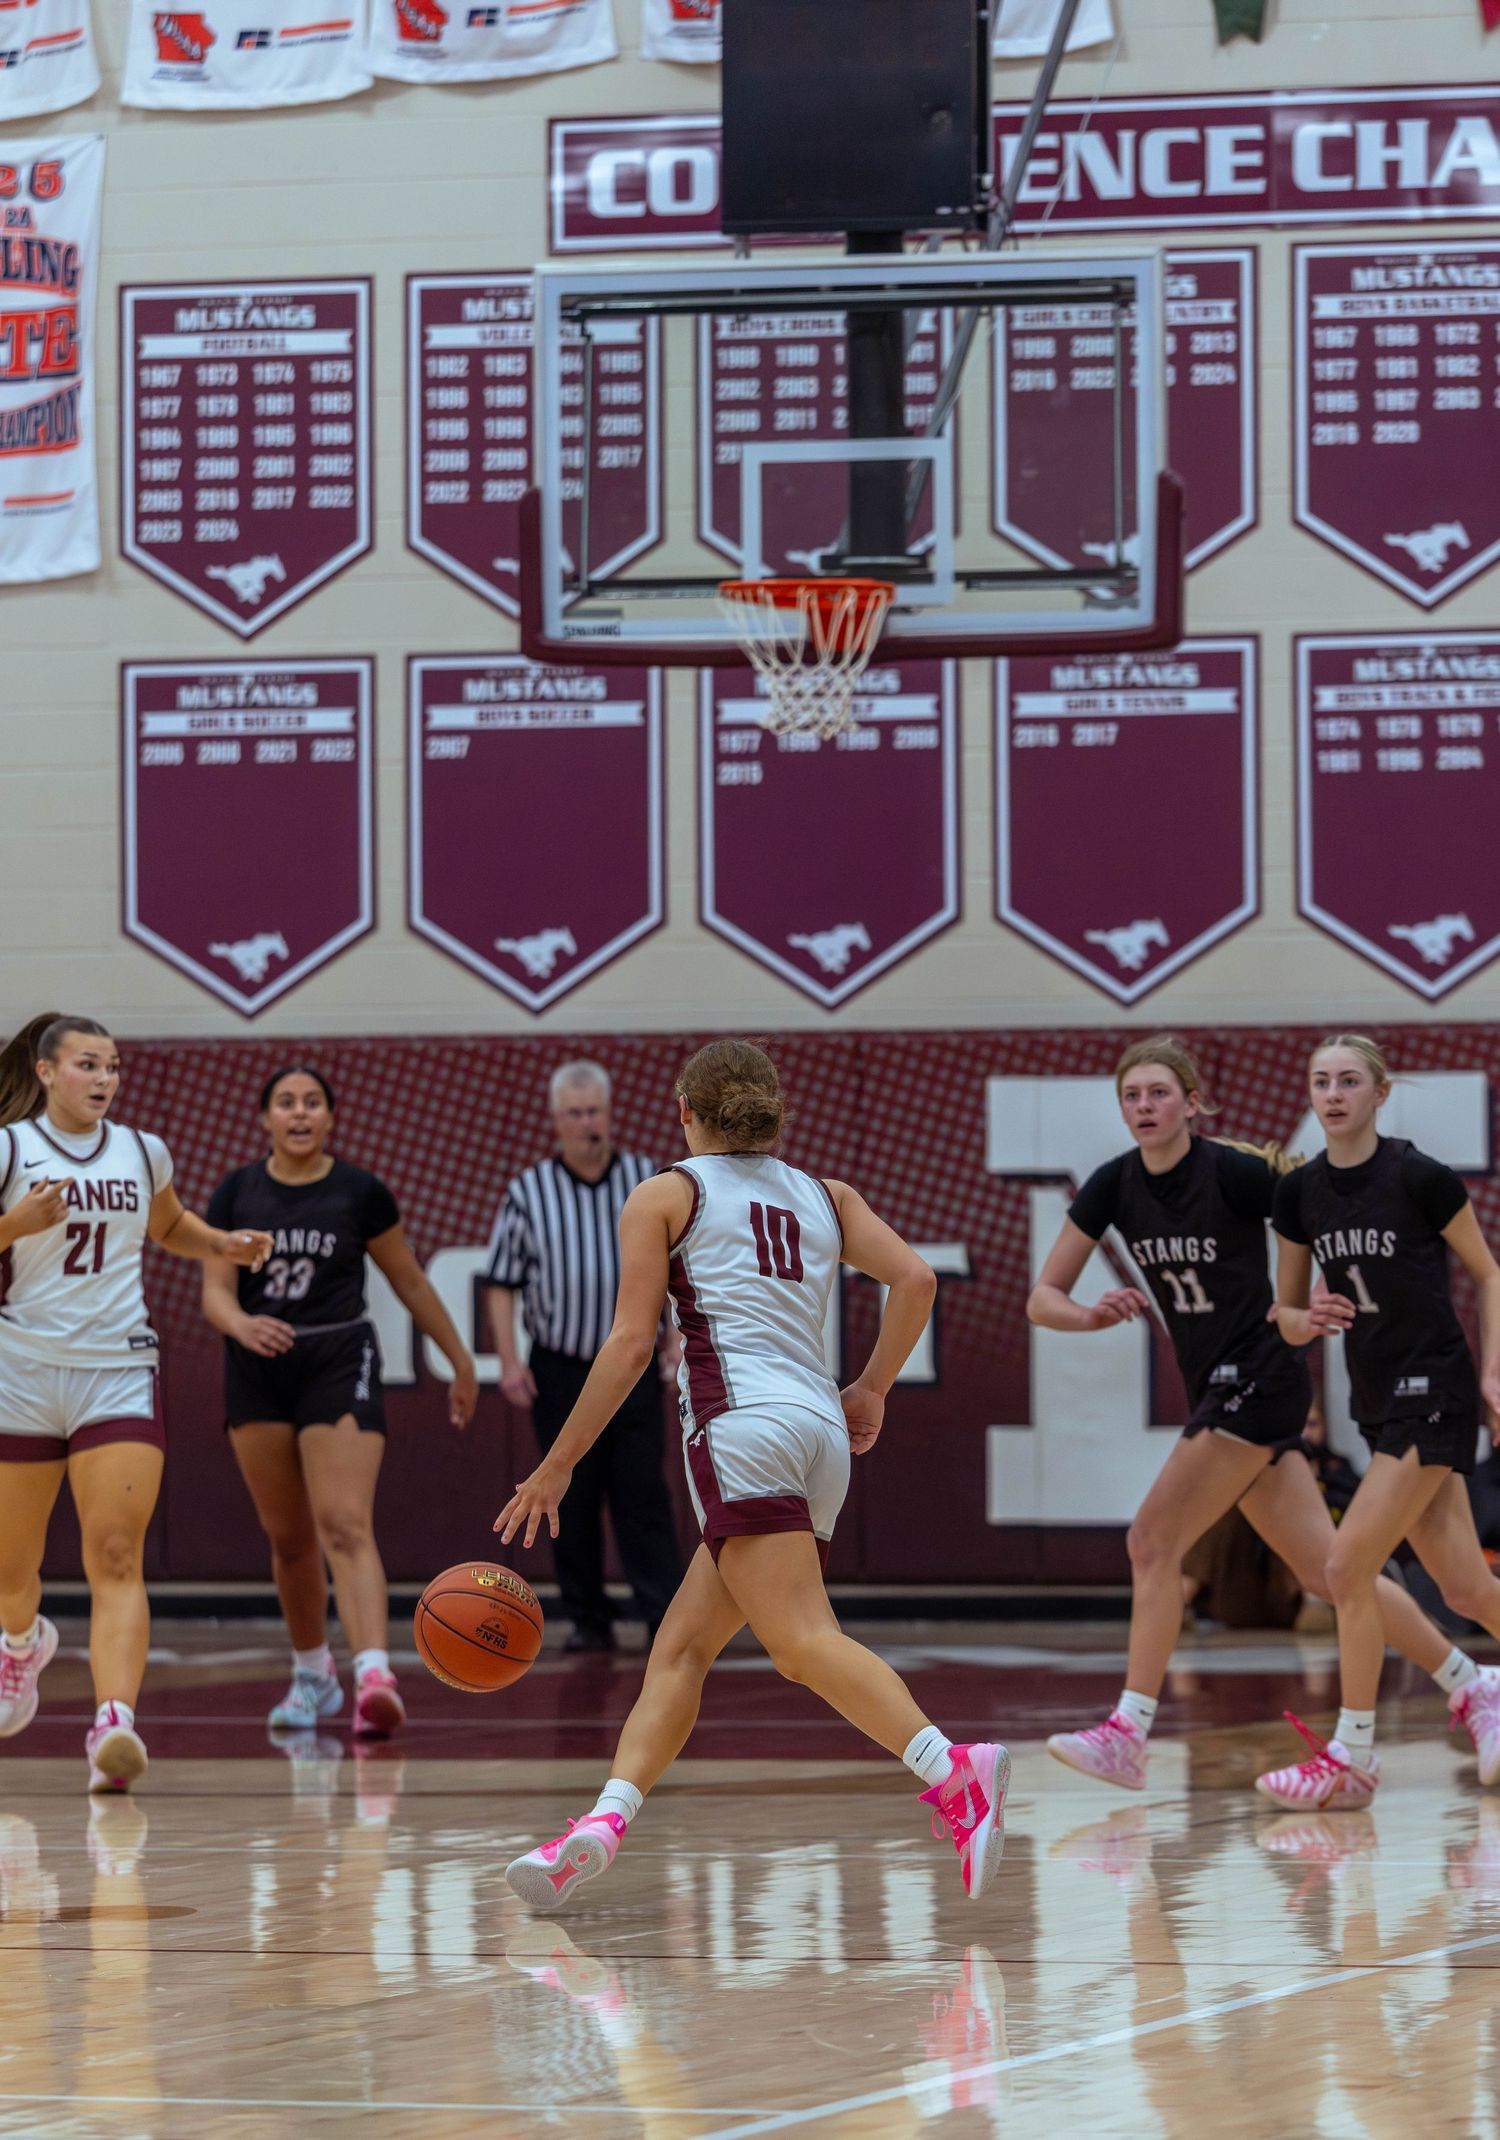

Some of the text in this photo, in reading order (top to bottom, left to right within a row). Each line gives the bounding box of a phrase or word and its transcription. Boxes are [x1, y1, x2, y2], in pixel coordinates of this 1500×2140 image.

[175, 304, 316, 332] MUSTANGS
[200, 336, 286, 350] FOOTBALL
[464, 675, 607, 703] MUSTANGS
[1051, 661, 1199, 690] MUSTANGS
[177, 683, 319, 711] MUSTANGS
[63, 1222, 108, 1276] 21
[749, 1201, 804, 1284] 10
[1132, 1236, 1217, 1267] STANGS
[1312, 1228, 1397, 1264] STANGS
[264, 1257, 316, 1301] 33
[1161, 1267, 1214, 1314] 11
[1346, 1264, 1379, 1314] 1
[482, 1629, 508, 1650] NFHS
